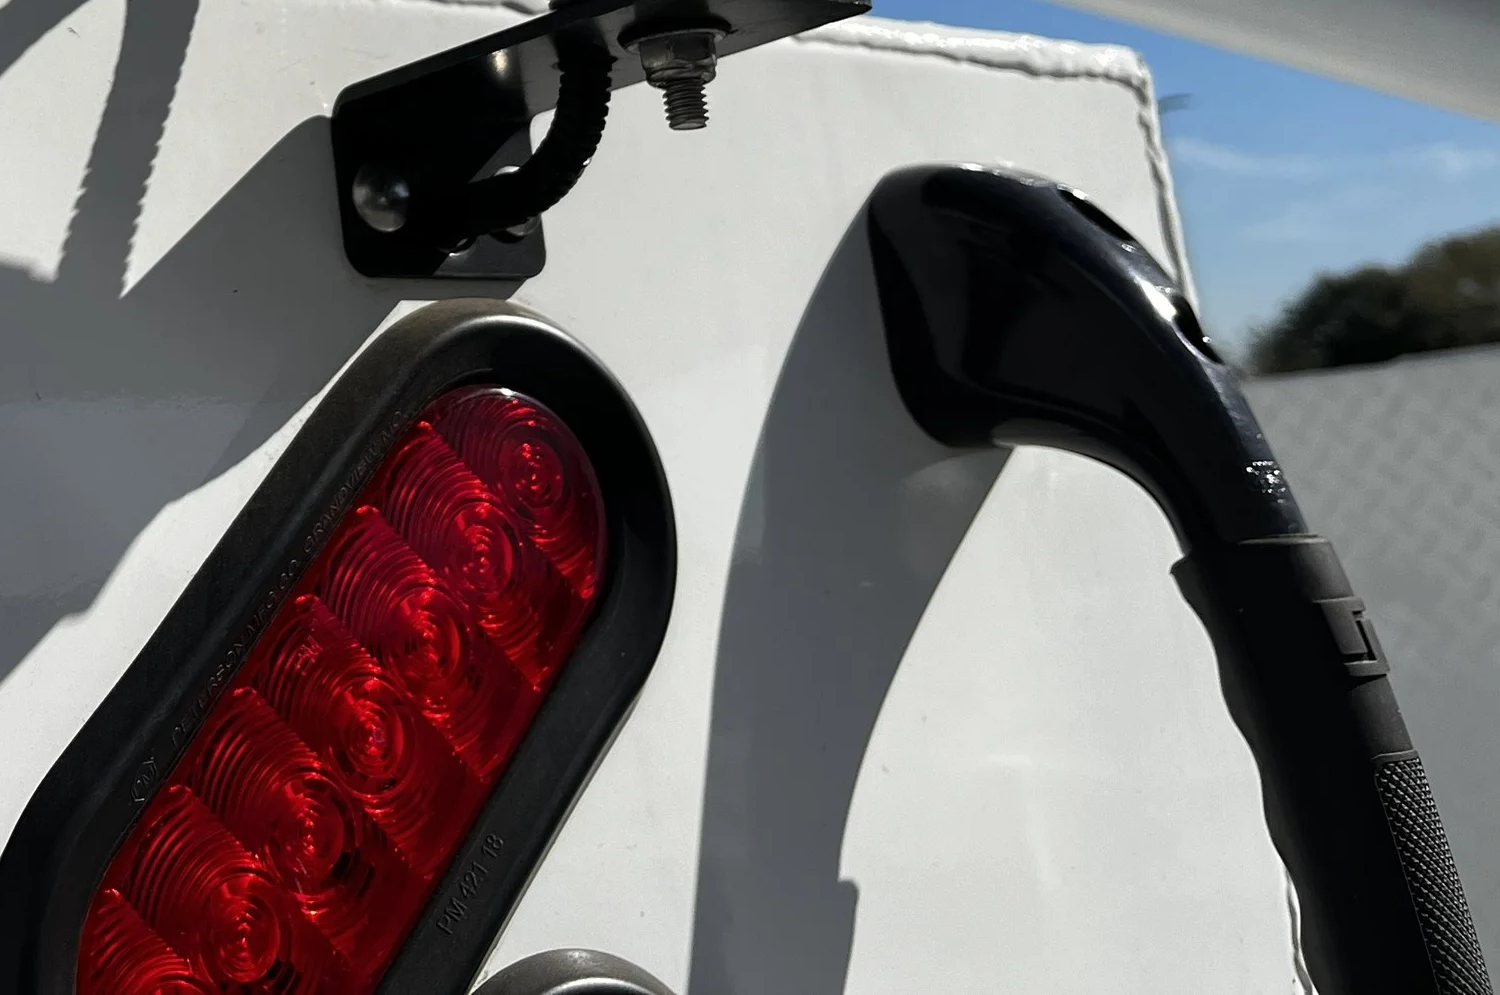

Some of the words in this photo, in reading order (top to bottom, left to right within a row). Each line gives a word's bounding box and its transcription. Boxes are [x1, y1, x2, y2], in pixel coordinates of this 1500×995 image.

[436, 896, 468, 935] PM
[460, 861, 488, 897] 421
[482, 833, 504, 857] 18
